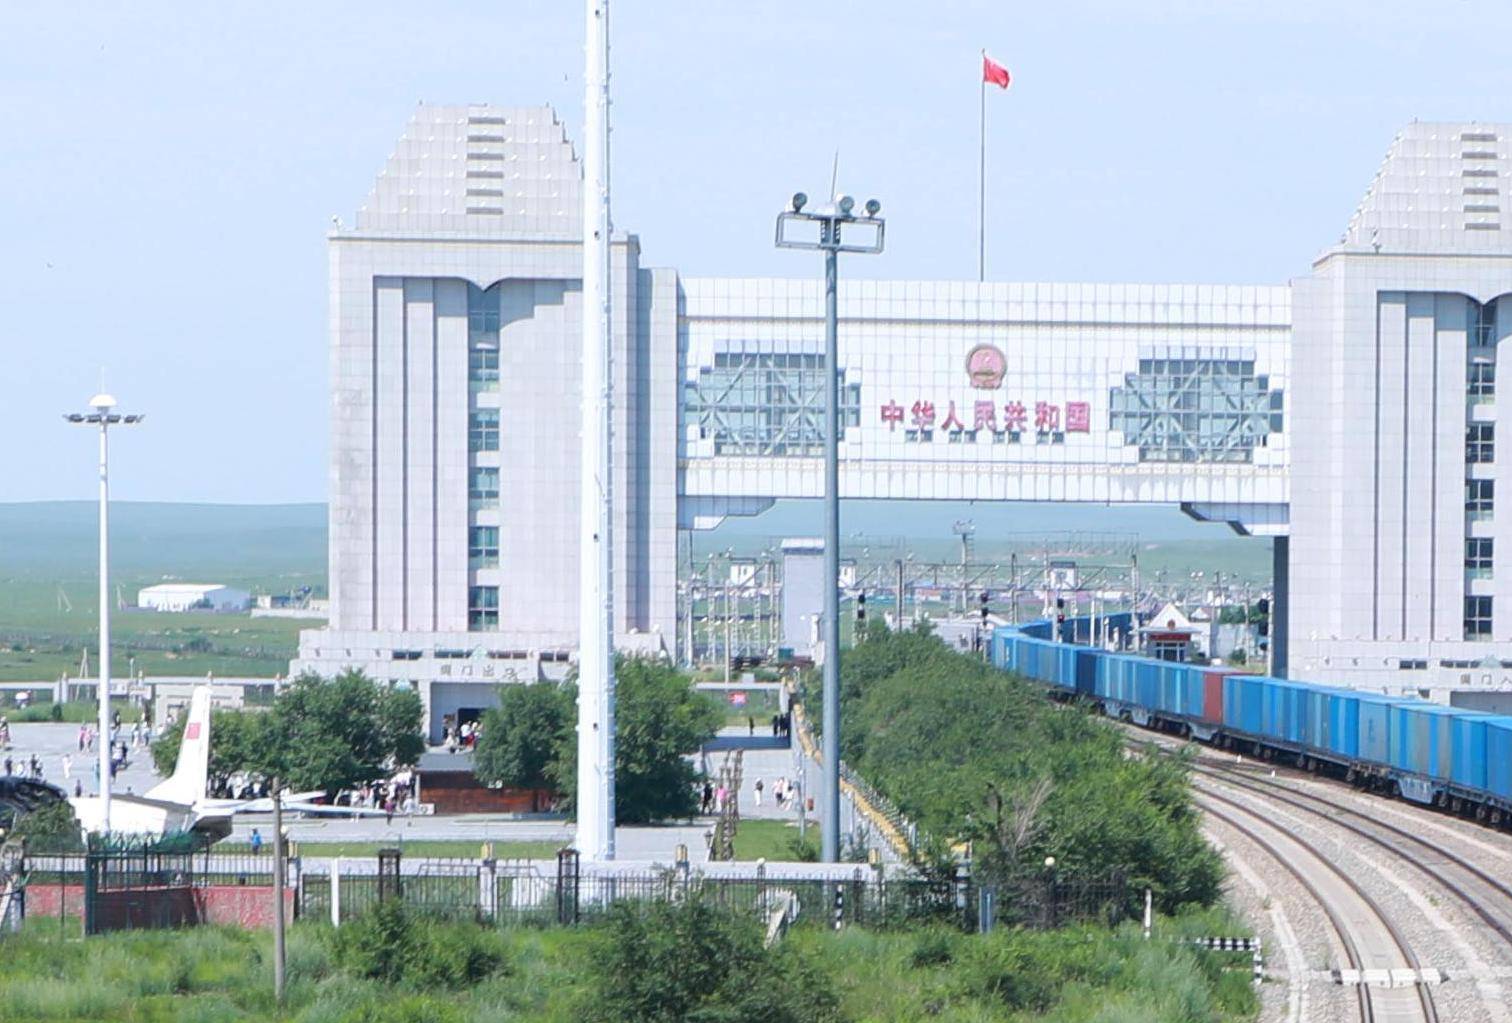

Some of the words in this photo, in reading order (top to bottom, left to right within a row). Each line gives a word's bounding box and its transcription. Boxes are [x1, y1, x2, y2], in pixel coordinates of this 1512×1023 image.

[881, 400, 1090, 433] 中华人民共和国
